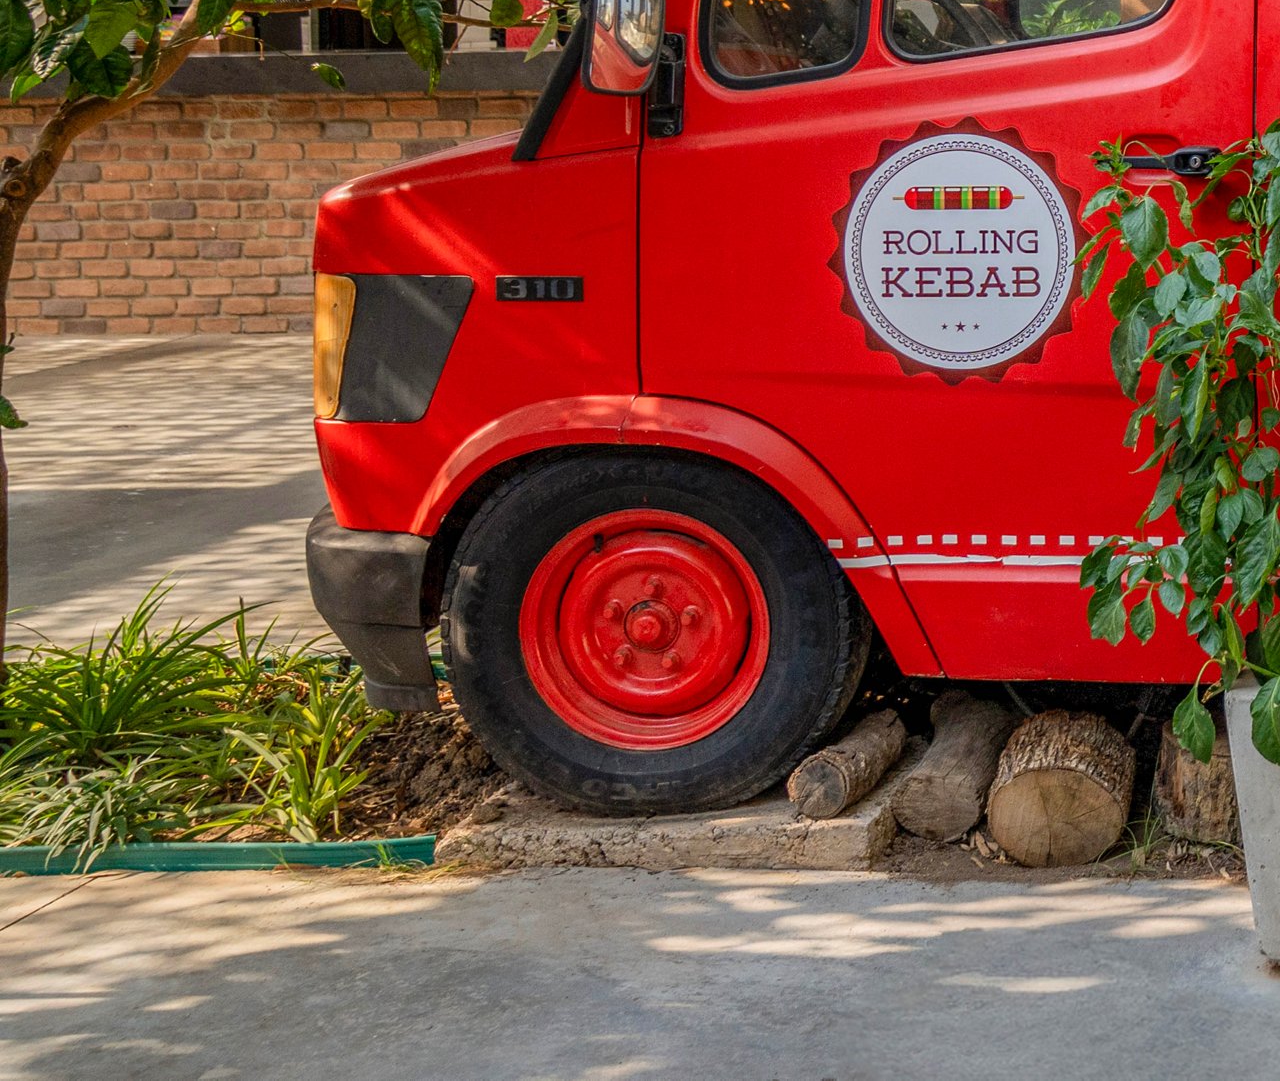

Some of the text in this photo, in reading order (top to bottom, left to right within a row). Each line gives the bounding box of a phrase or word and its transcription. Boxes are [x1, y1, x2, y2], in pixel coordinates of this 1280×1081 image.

[882, 229, 1039, 256] ROLLING
[503, 278, 576, 299] 310
[881, 266, 1042, 298] KEBAB
